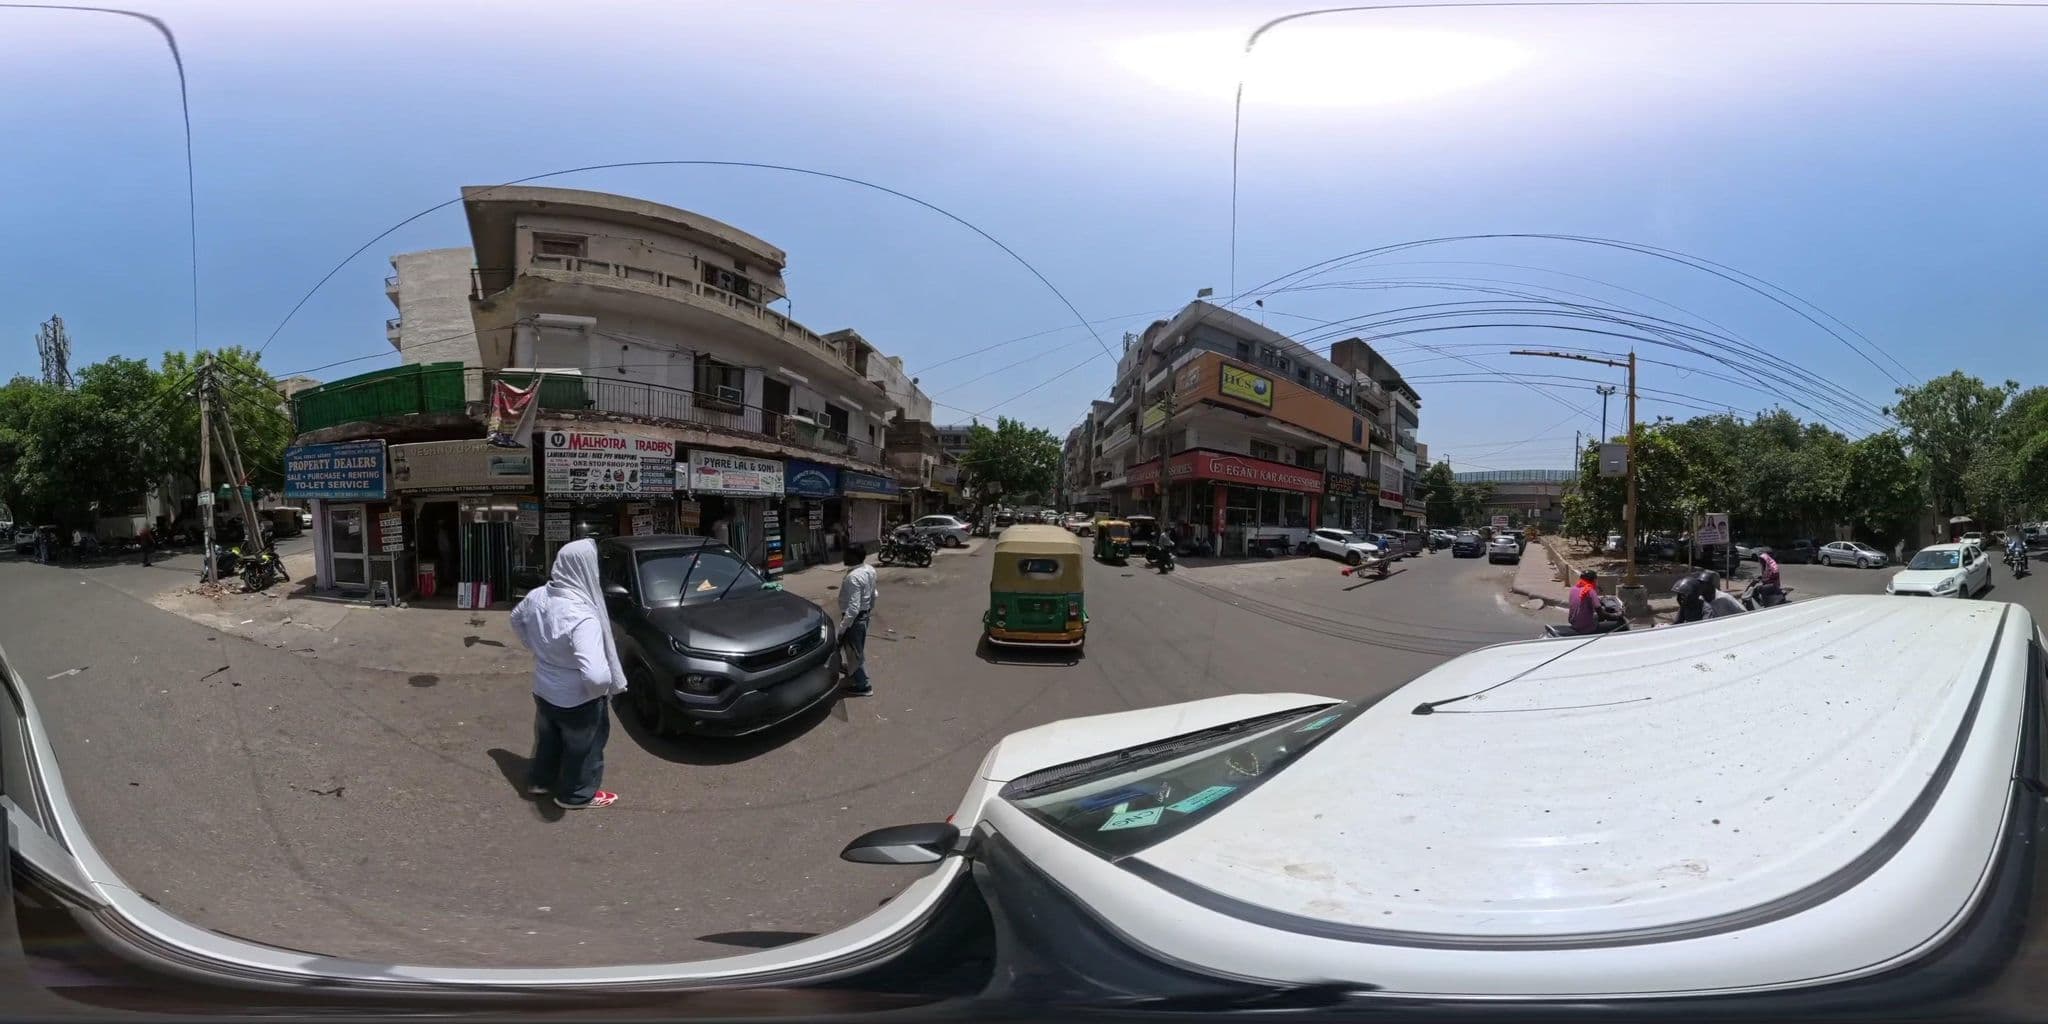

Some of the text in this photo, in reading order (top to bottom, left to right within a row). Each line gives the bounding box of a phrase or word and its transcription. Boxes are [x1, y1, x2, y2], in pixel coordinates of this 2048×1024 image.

[568, 432, 673, 457] MALHOTRA TRADERS
[288, 456, 377, 471] PROPERTY DEALERS
[704, 457, 775, 473] PYARE LAL & SONS
[287, 470, 380, 481] SALE PURCHASE RENTING
[1260, 469, 1277, 482] KAR
[295, 480, 369, 489] TO-LET SERVICE
[1112, 810, 1153, 826] CNG
